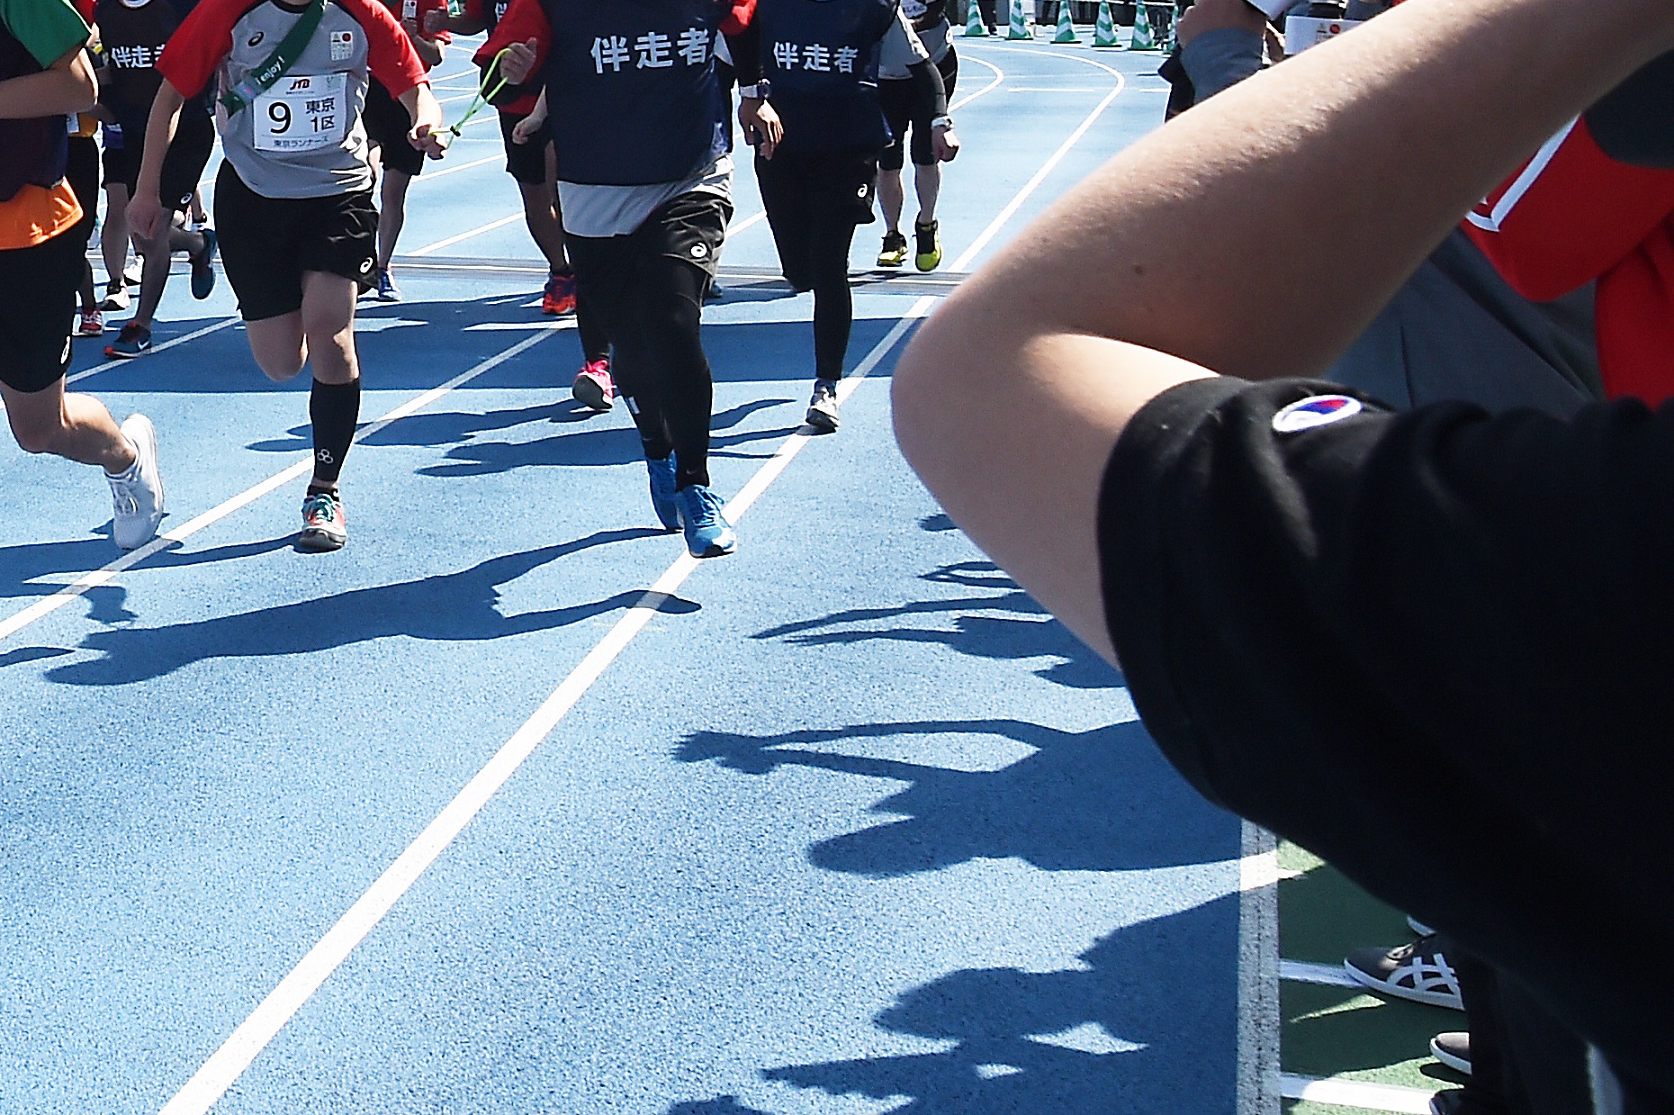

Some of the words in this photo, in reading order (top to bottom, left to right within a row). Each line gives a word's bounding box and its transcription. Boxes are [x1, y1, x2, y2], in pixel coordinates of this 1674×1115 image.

[590, 27, 713, 74] 伴走者
[773, 40, 859, 74] 伴走者
[290, 78, 311, 91] JTB
[268, 101, 292, 135] 9
[305, 97, 336, 115] 東京
[310, 115, 336, 134] 1区
